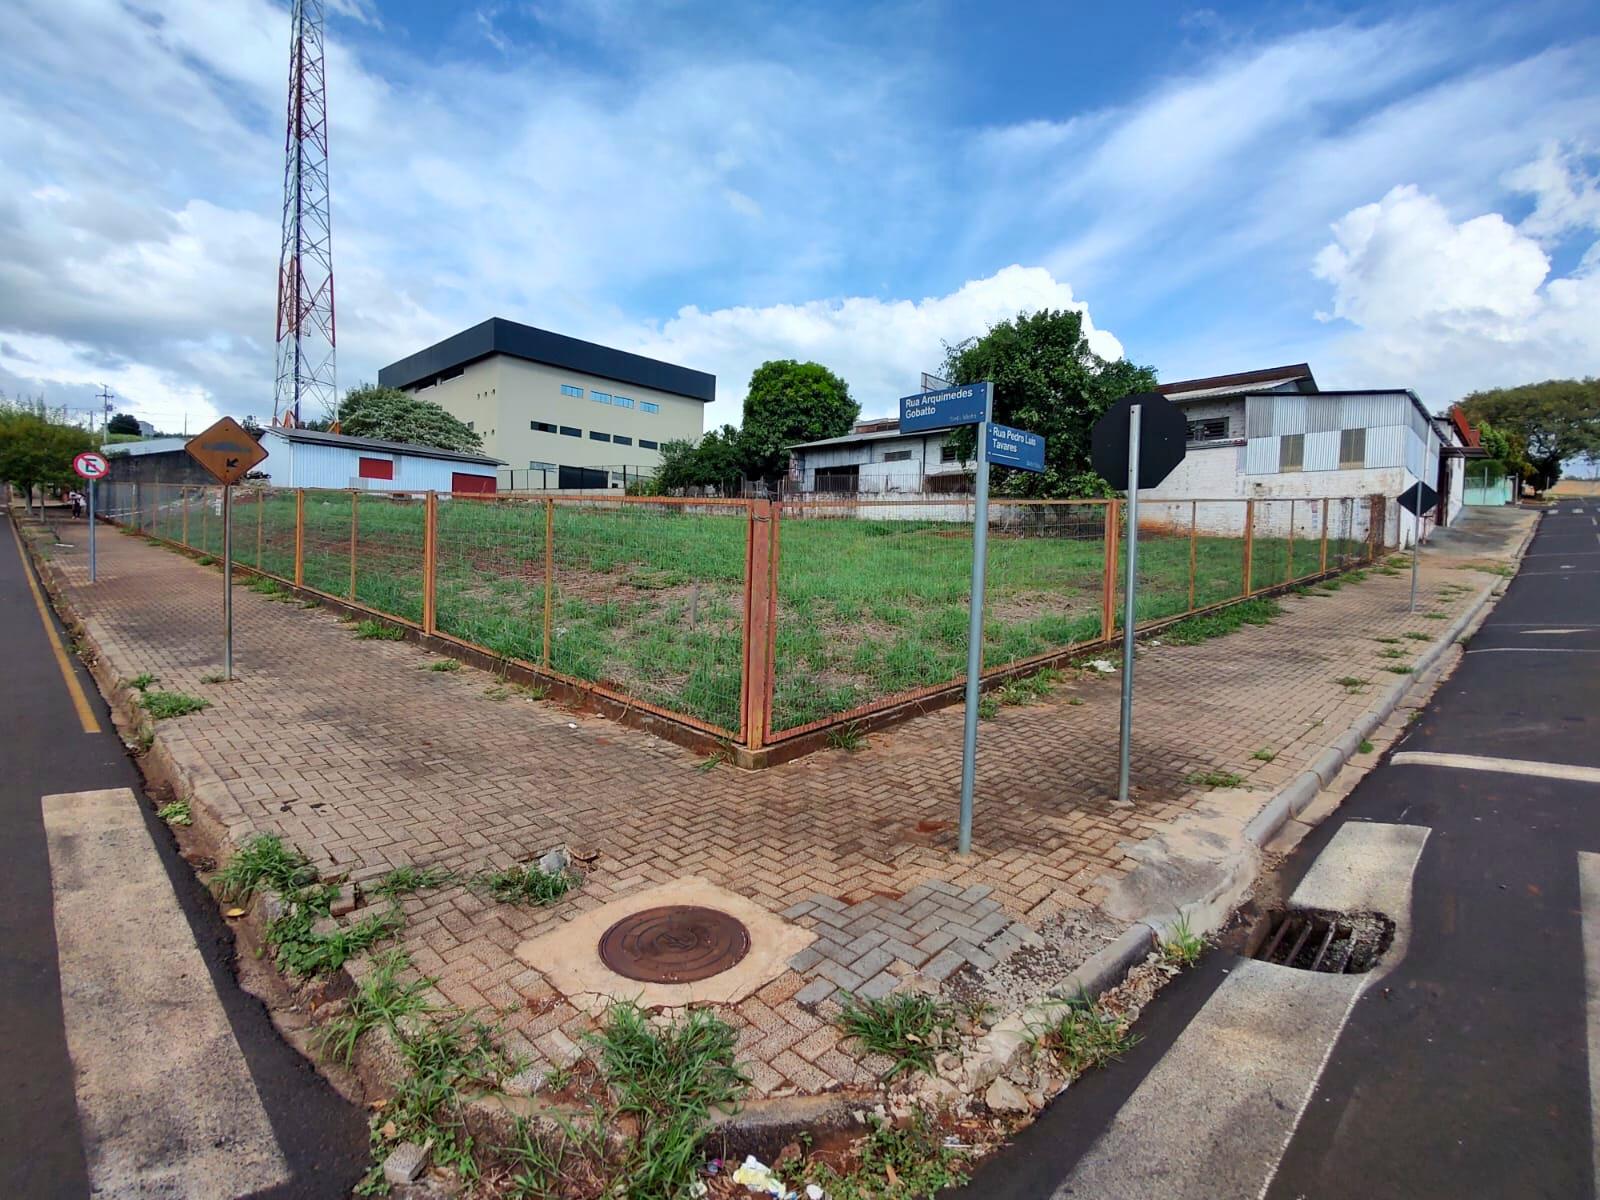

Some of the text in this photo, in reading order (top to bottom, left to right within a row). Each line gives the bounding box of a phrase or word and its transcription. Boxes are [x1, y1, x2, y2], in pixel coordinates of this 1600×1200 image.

[906, 389, 972, 408] Rua Arquimedes
[906, 406, 936, 418] Gobatto
[992, 427, 1006, 439] Rua
[1007, 430, 1024, 443] Pedro
[992, 438, 1017, 453] Tavares
